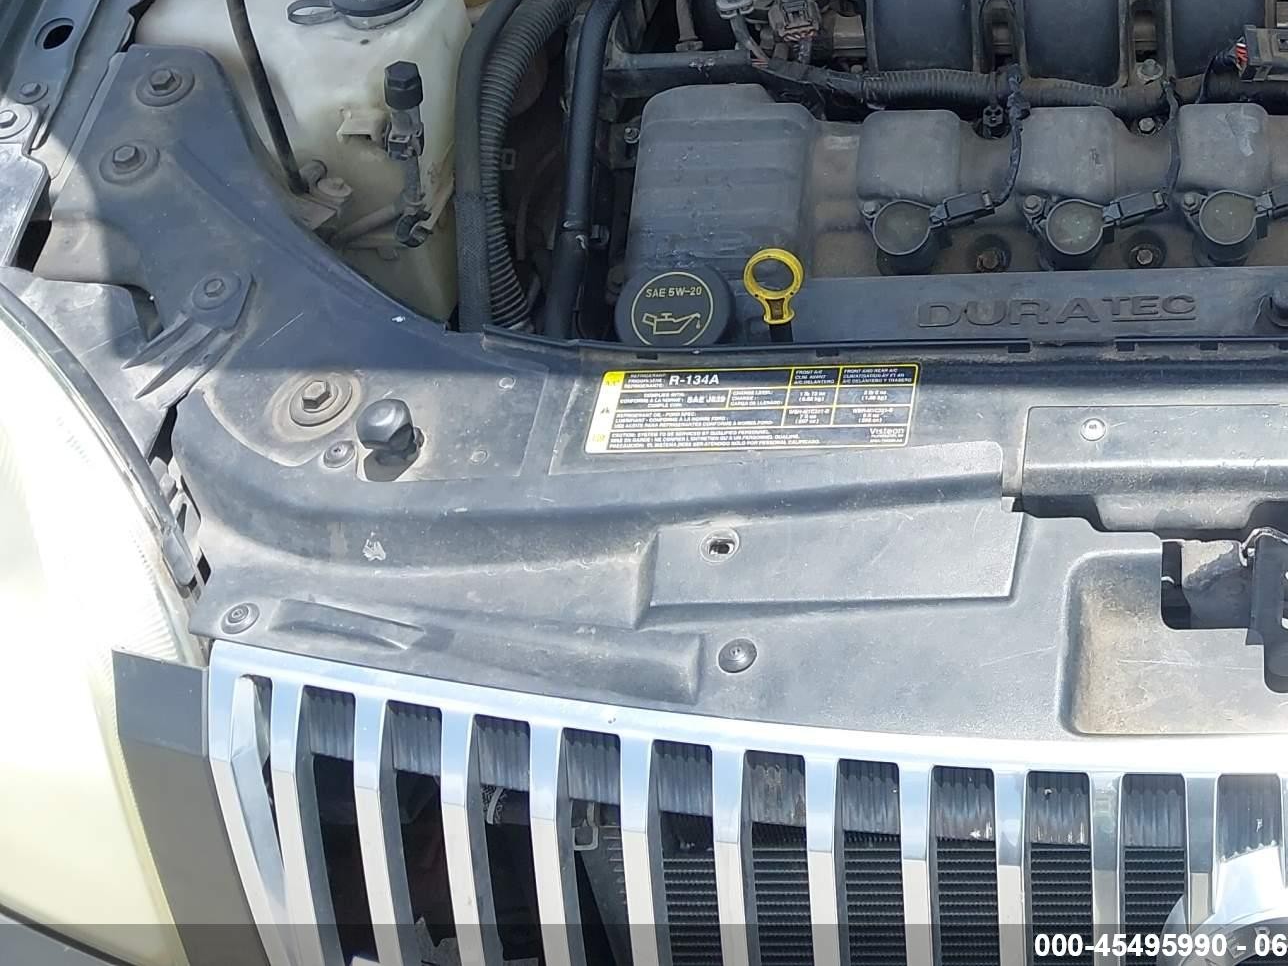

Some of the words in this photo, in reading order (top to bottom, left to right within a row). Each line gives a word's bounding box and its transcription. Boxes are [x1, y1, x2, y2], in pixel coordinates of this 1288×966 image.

[645, 287, 667, 298] SAE
[668, 286, 703, 297] 5W-20
[917, 295, 1197, 328] DURATEC
[668, 373, 720, 386] R-134A
[869, 427, 905, 435] Visteon
